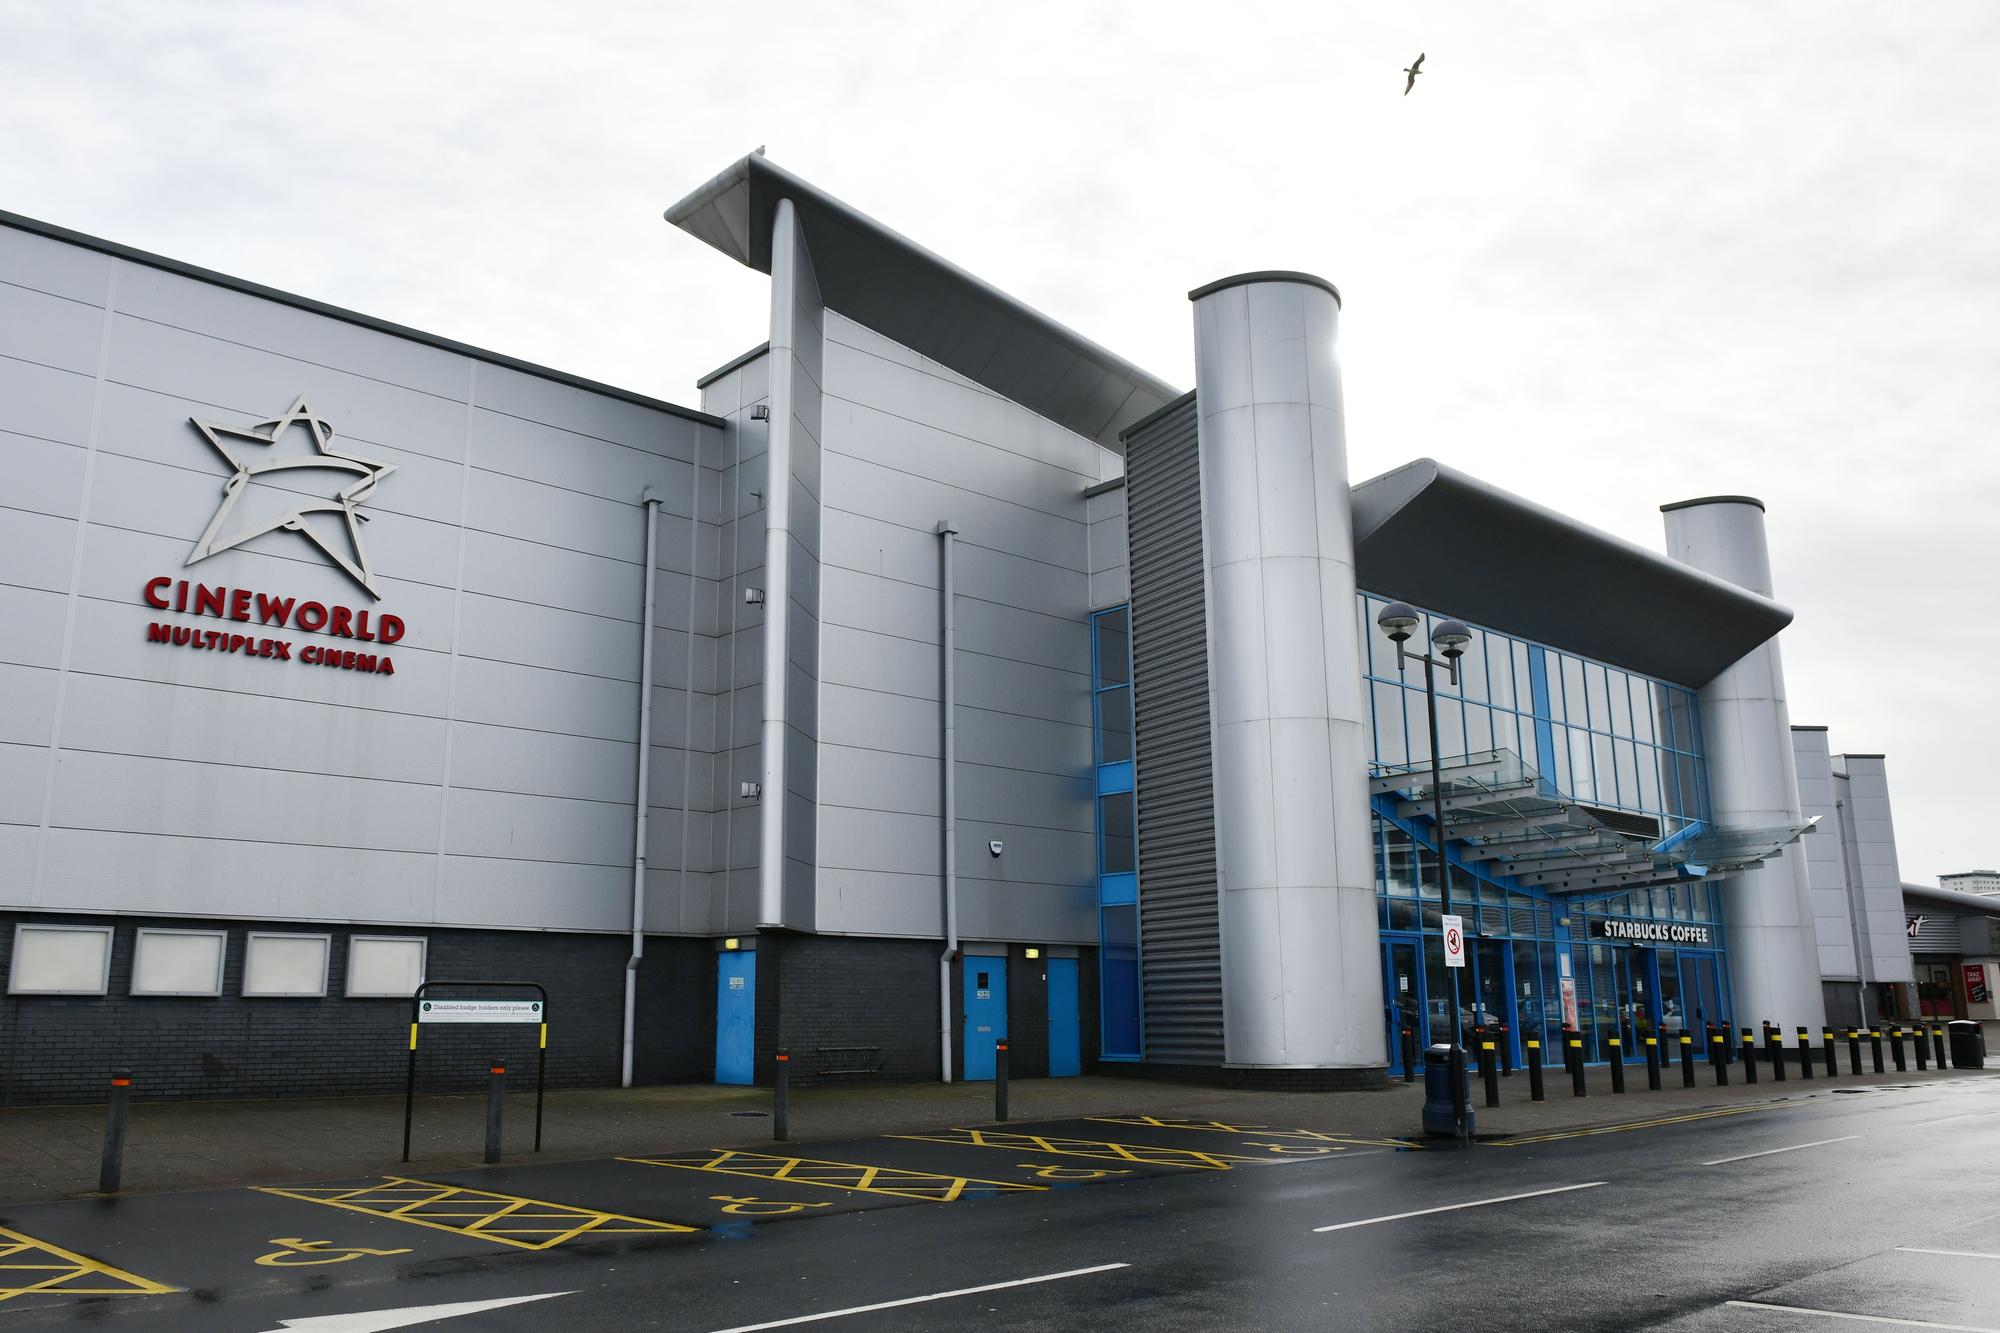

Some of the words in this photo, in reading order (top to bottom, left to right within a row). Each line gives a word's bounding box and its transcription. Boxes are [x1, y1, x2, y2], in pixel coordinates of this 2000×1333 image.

[144, 576, 405, 644] CINEWORLD
[147, 622, 292, 661] MULTIPLEX
[300, 645, 395, 675] CINEMA
[1604, 920, 1669, 941] STARBUCKS
[1670, 925, 1708, 943] COFFEE
[460, 1003, 478, 1012] badge
[478, 1003, 499, 1011] holders
[499, 1003, 511, 1012] only
[512, 1004, 530, 1012] please
